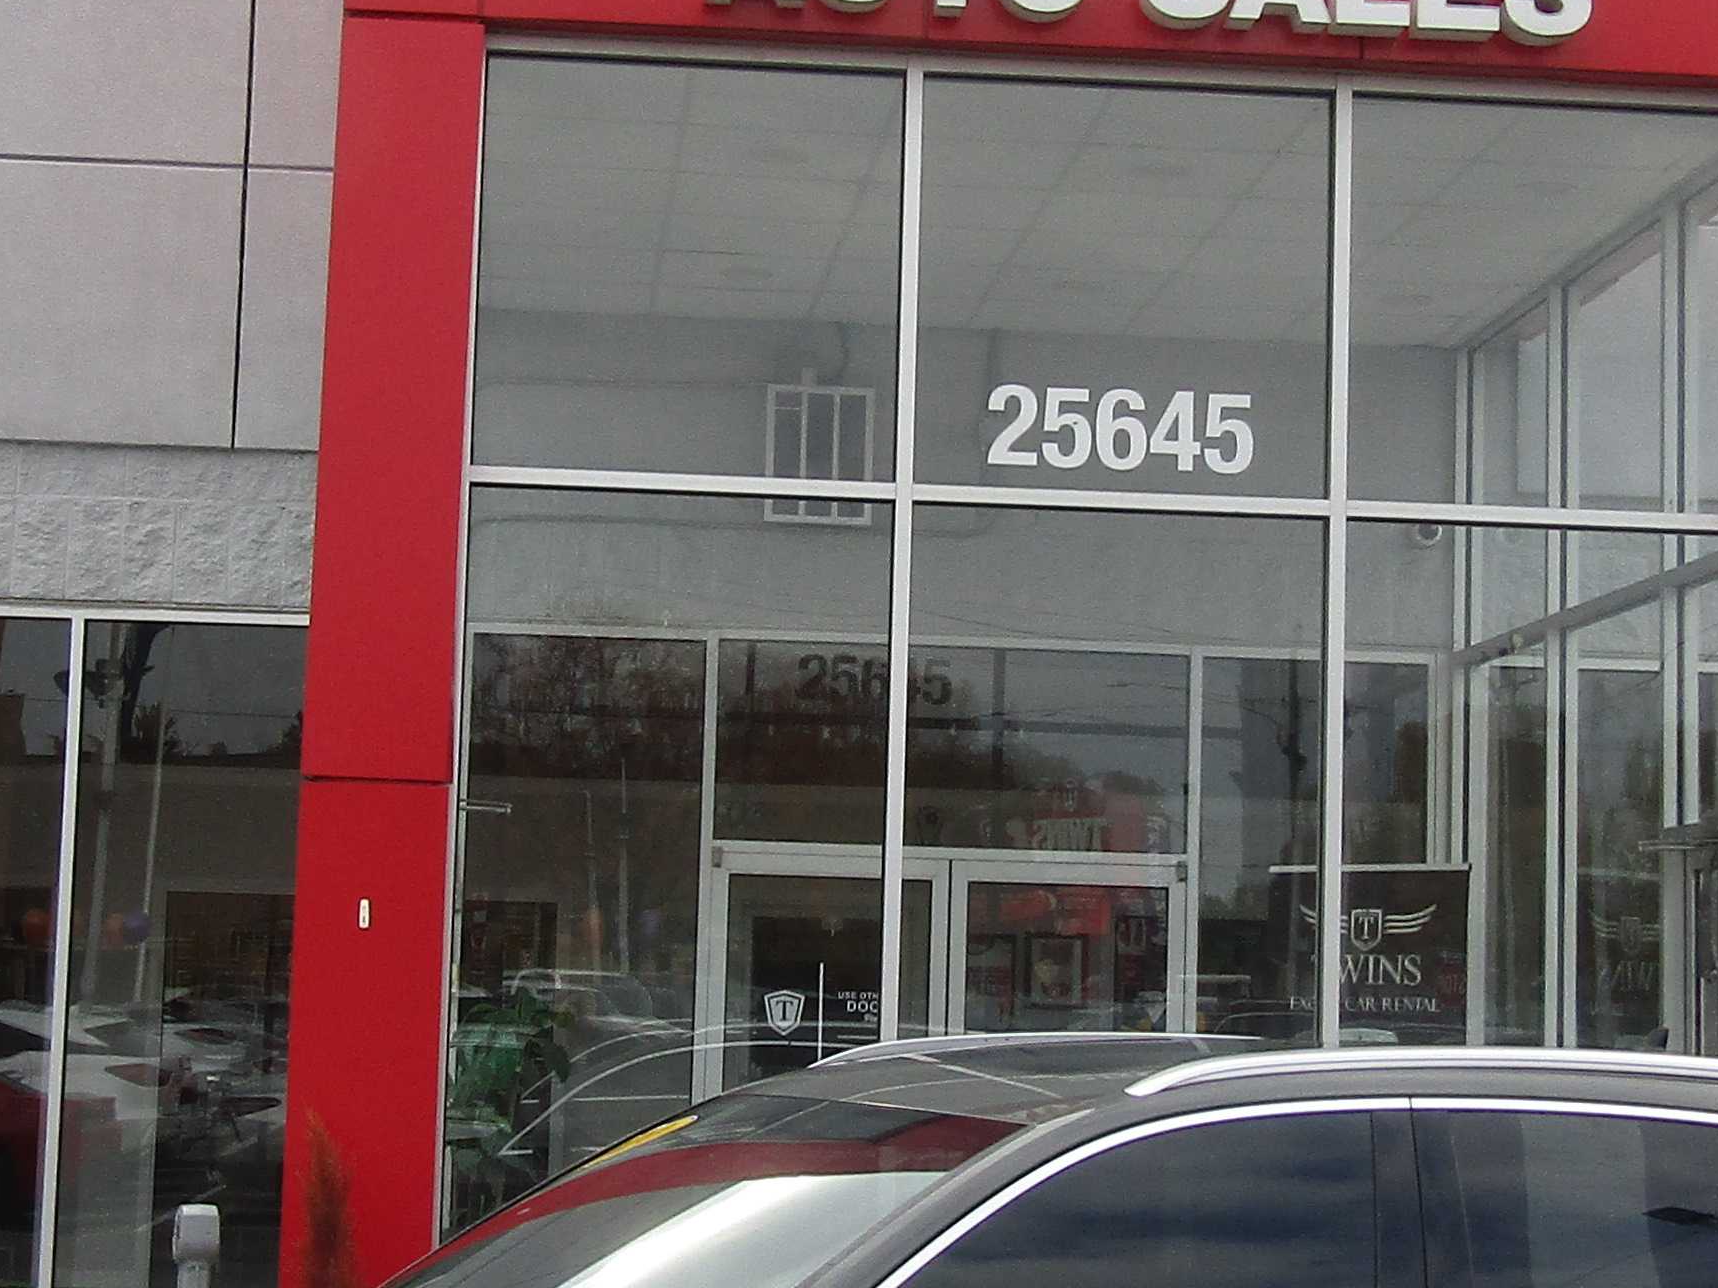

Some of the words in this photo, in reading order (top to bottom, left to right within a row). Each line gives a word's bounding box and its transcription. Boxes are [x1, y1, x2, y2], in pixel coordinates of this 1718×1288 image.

[986, 384, 1254, 475] 25645
[796, 654, 953, 706] 2565
[1310, 953, 1422, 986] WINS
[838, 991, 857, 999] USE
[859, 991, 878, 1000] OTH
[847, 1000, 878, 1013] DOO
[1345, 996, 1376, 1011] CAR
[1382, 996, 1441, 1012] RENTAL
